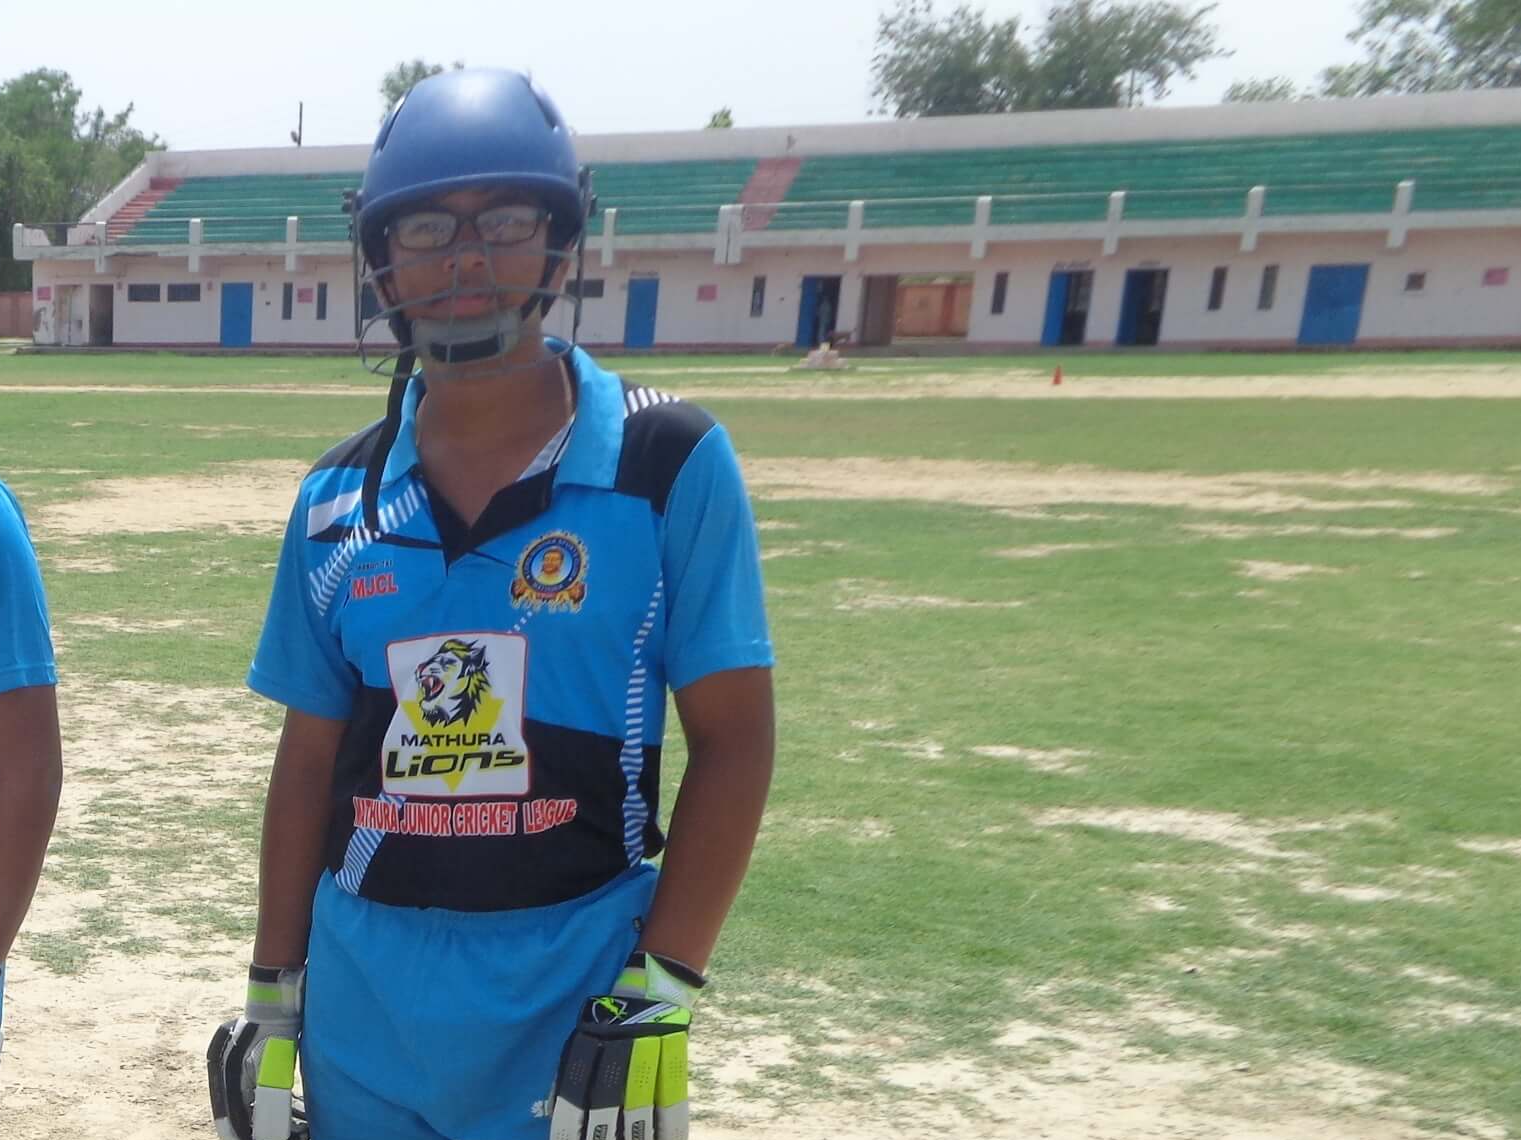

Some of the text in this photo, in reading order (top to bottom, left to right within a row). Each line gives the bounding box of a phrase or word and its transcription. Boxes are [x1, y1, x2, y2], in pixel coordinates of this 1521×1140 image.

[353, 572, 399, 599] MJCL
[401, 733, 506, 747] MATHURA
[353, 797, 578, 836] MATHURA JUNIOR CRICKET LEAGUE
